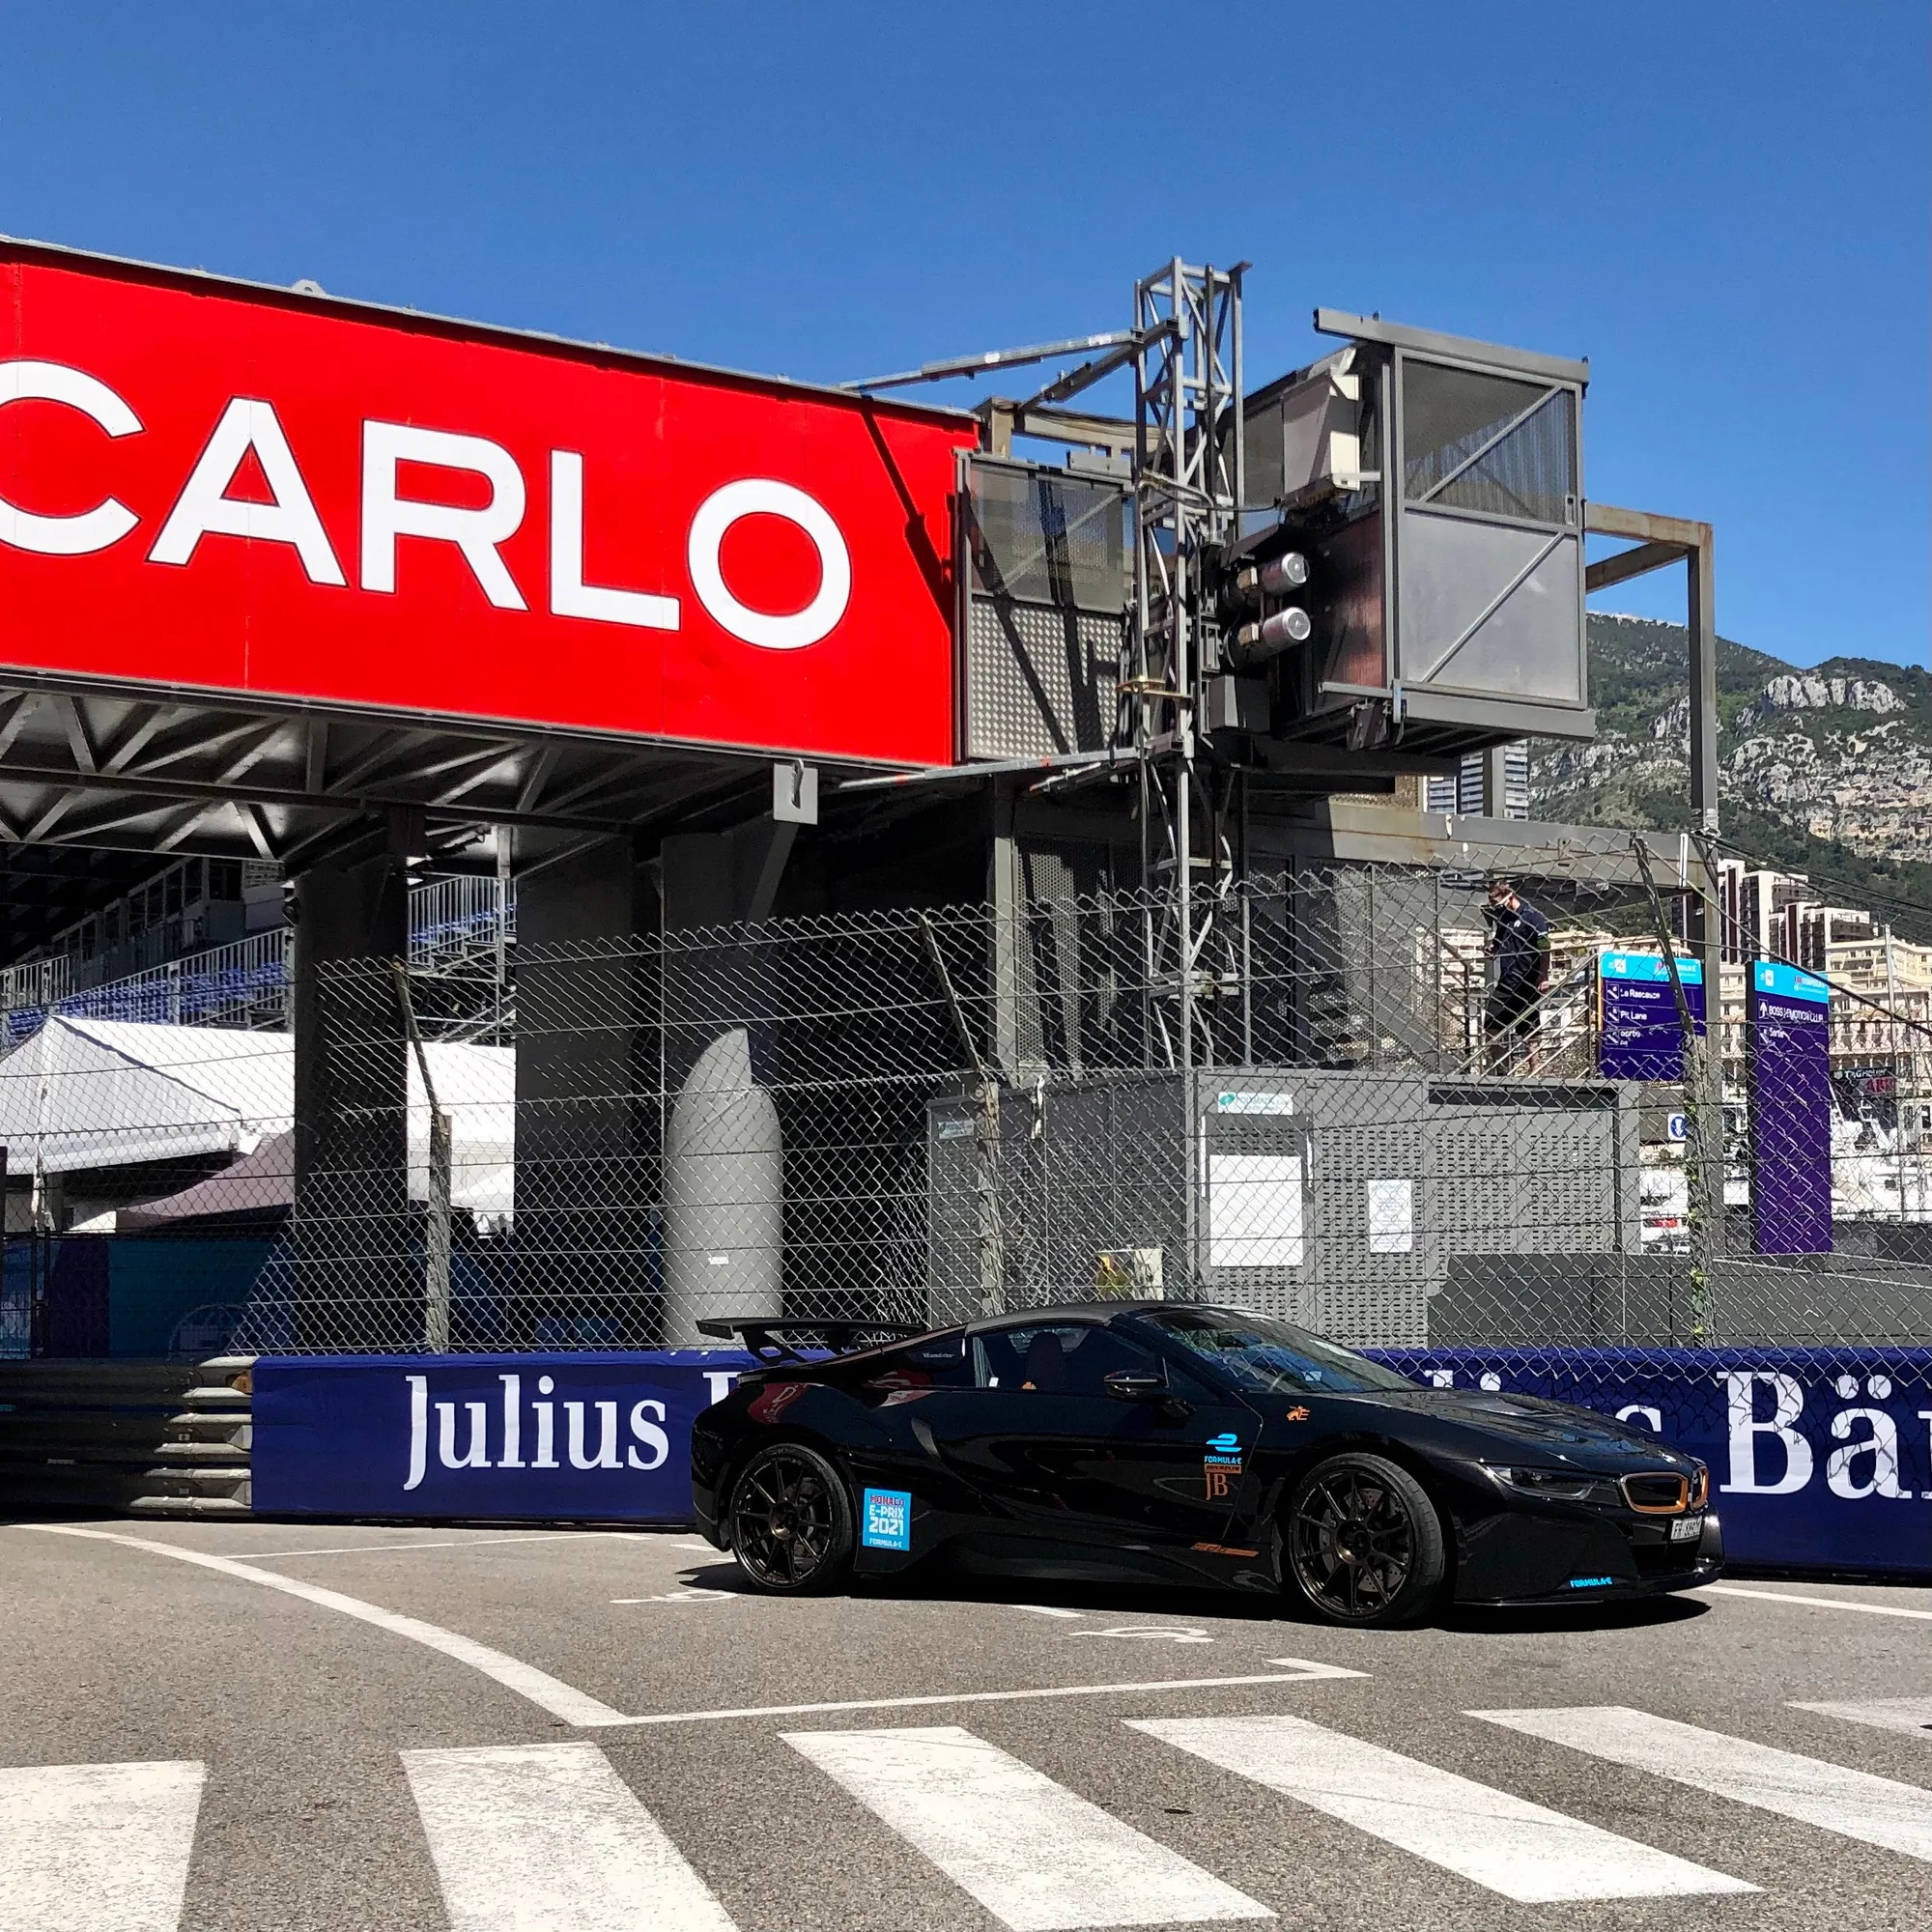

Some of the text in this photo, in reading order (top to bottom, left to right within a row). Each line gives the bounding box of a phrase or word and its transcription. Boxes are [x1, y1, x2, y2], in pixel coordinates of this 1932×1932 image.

[0, 359, 851, 649] CARLO
[403, 1374, 670, 1492] Julius
[1717, 1371, 1932, 1499] Bä
[869, 1503, 905, 1520] E-PRIX
[1205, 1473, 1230, 1501] JB
[868, 1516, 904, 1537] 2021
